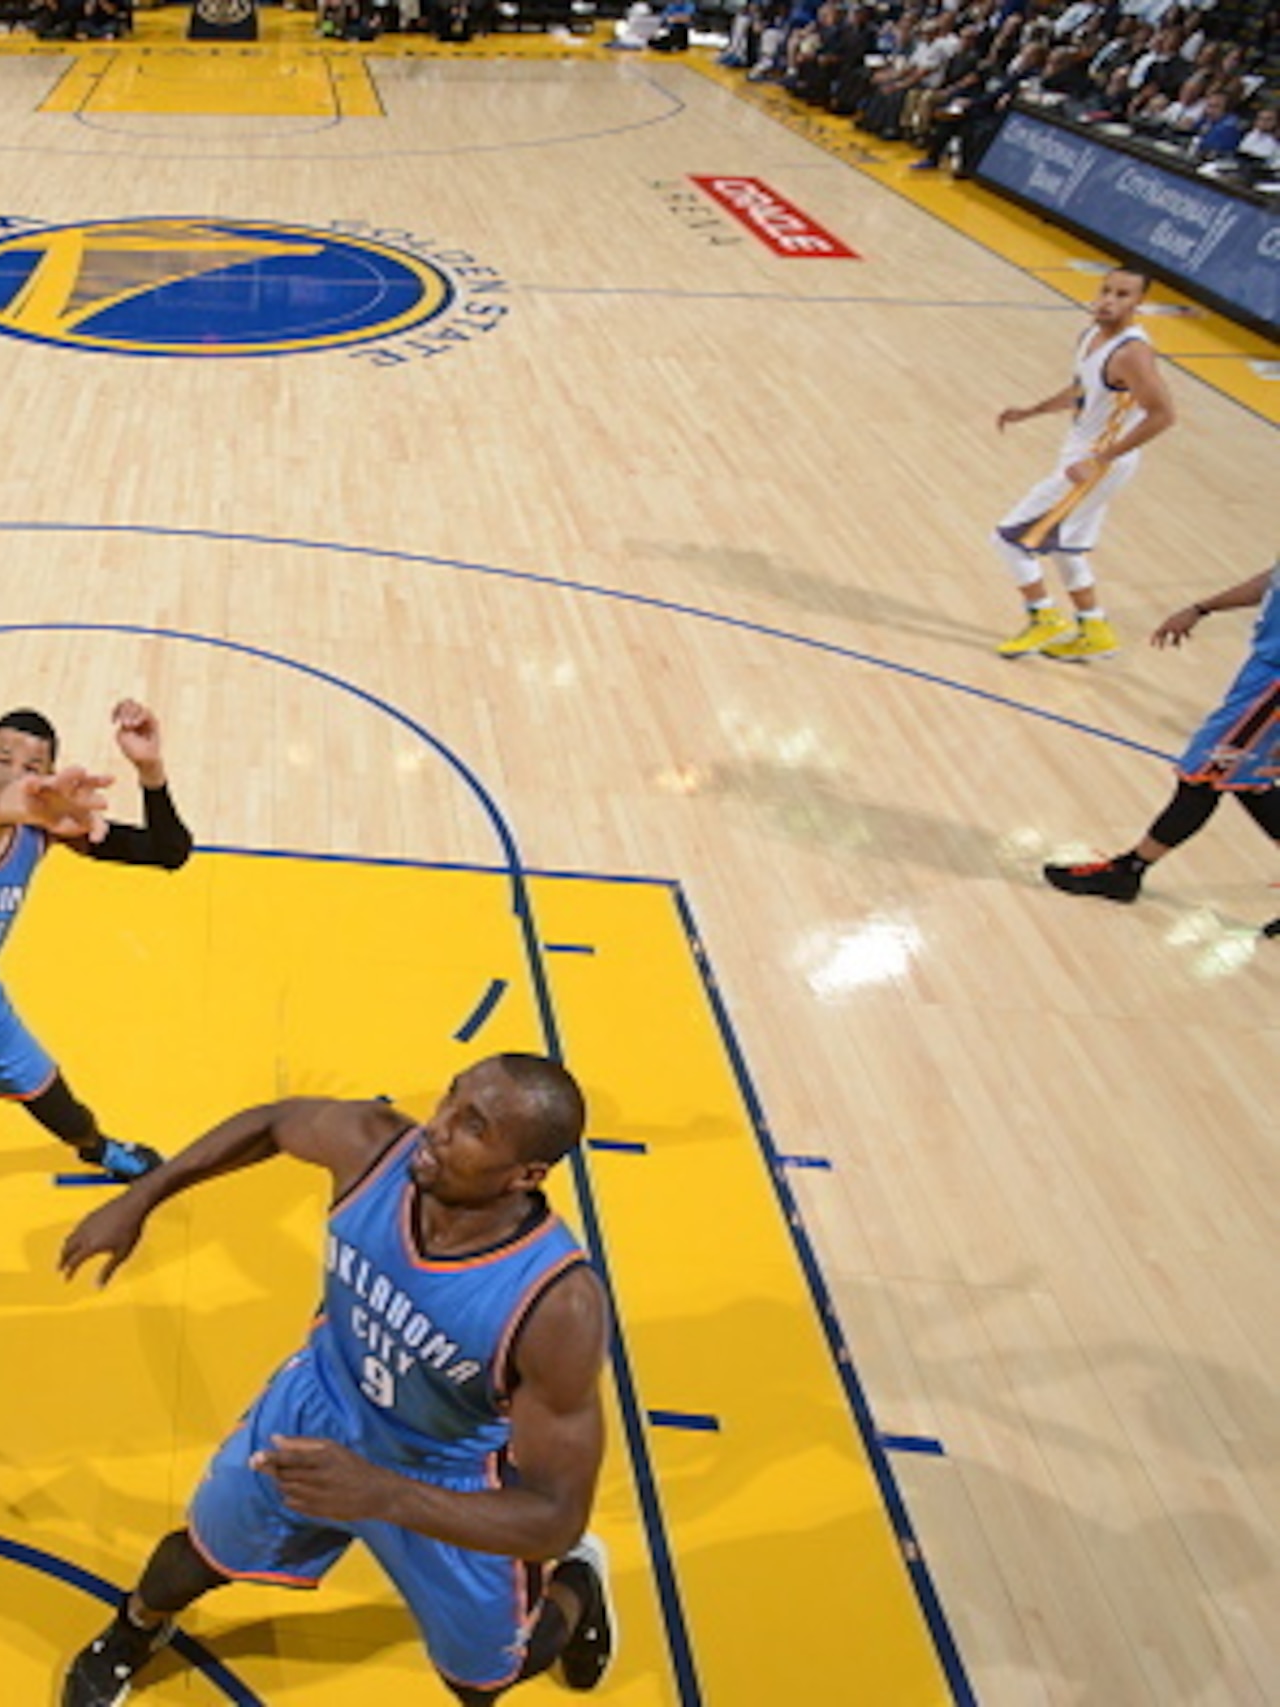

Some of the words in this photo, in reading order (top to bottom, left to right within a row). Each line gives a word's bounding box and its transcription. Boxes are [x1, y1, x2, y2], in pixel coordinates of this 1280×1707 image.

[713, 179, 834, 251] ORACLE
[348, 301, 509, 368] STATE
[351, 1304, 417, 1377] CITY
[359, 1354, 396, 1410] 9
